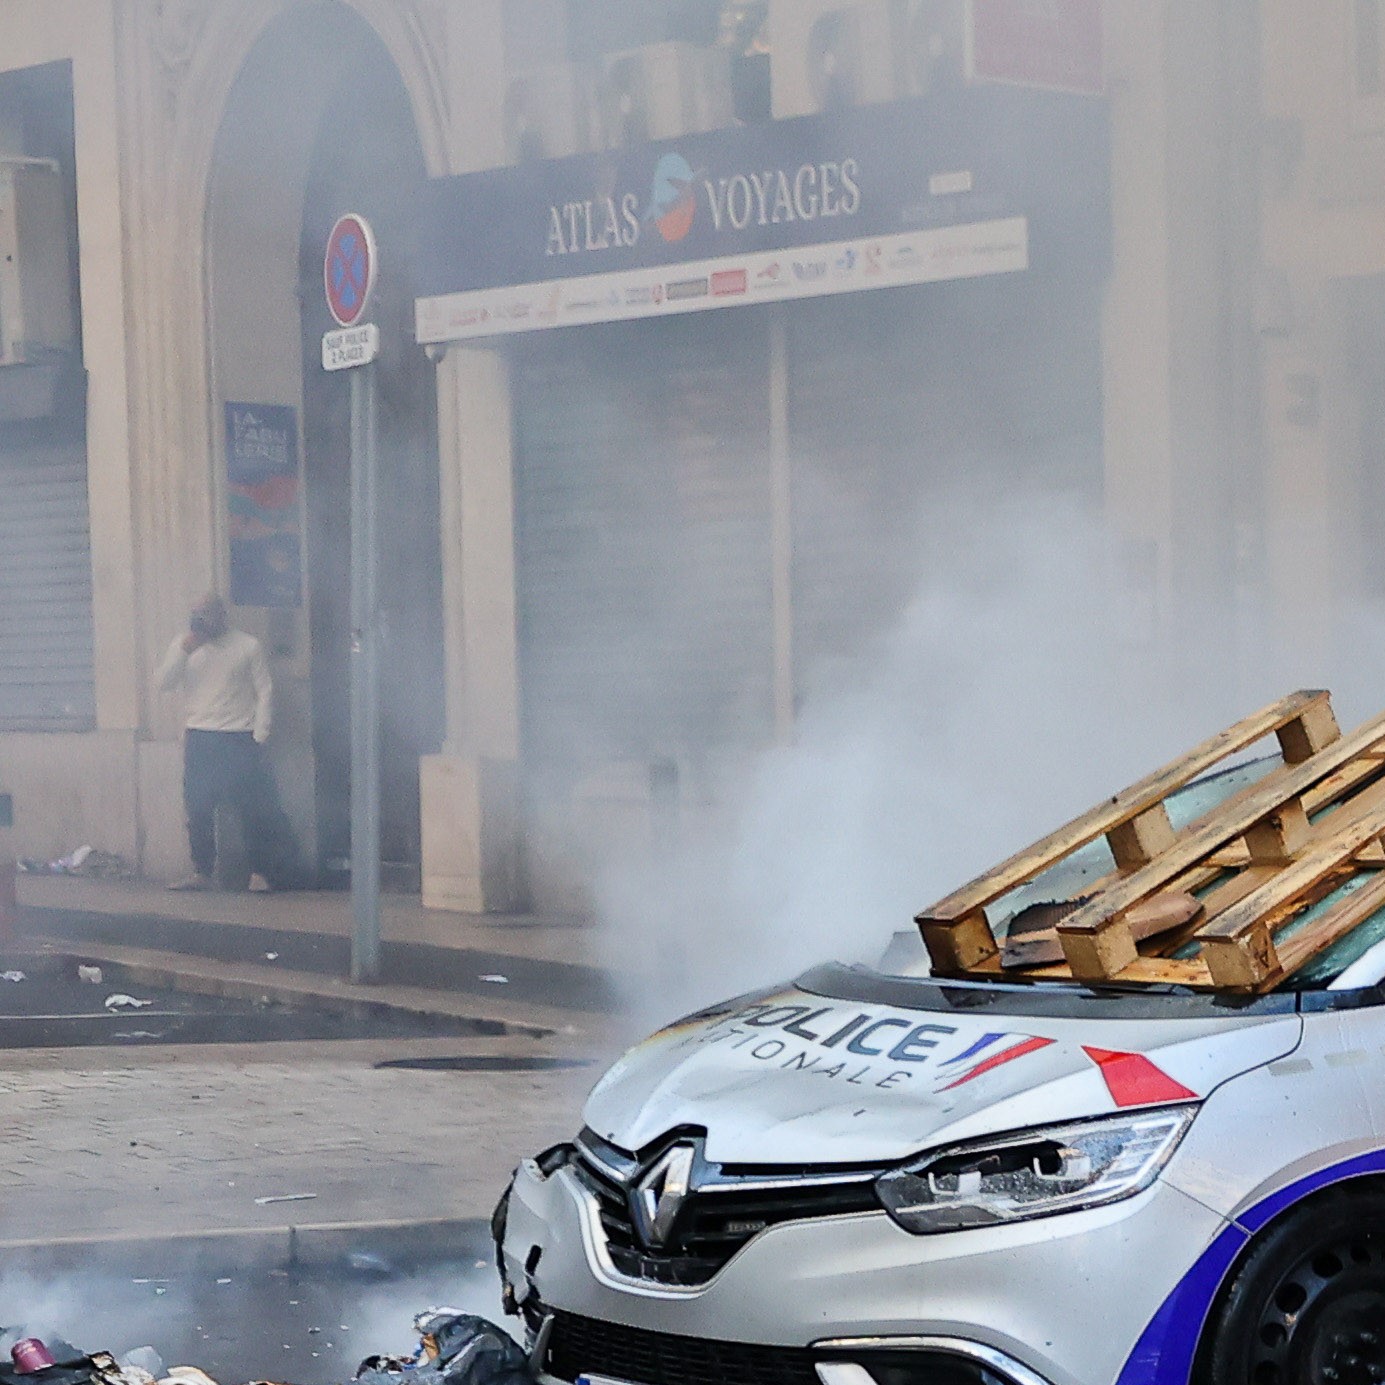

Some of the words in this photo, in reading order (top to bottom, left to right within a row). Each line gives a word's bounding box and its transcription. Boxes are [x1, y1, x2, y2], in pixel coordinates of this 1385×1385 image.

[546, 193, 640, 255] ATLAS
[704, 158, 861, 231] VOYAGES
[706, 1004, 958, 1062] POLICE
